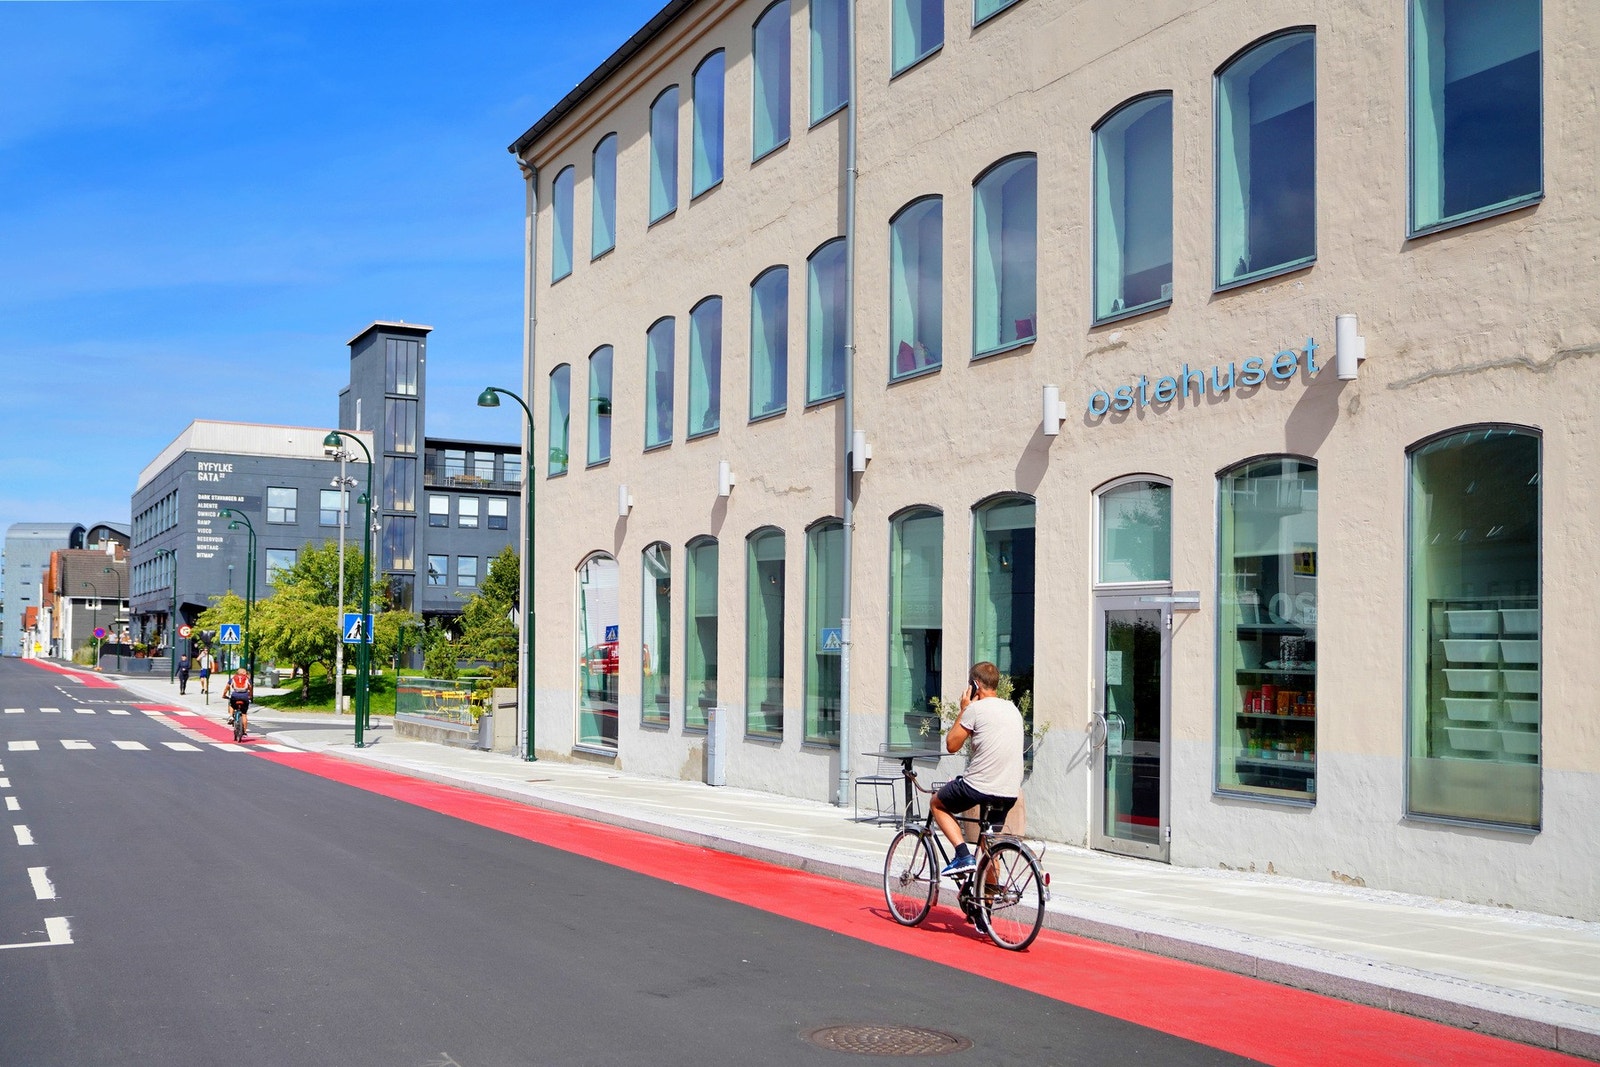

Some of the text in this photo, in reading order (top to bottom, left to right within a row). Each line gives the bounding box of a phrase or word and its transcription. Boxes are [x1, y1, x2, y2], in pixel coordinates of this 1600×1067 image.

[1088, 337, 1321, 416] ostehuset
[198, 462, 233, 473] RYFYLKE
[198, 472, 219, 482] GATA
